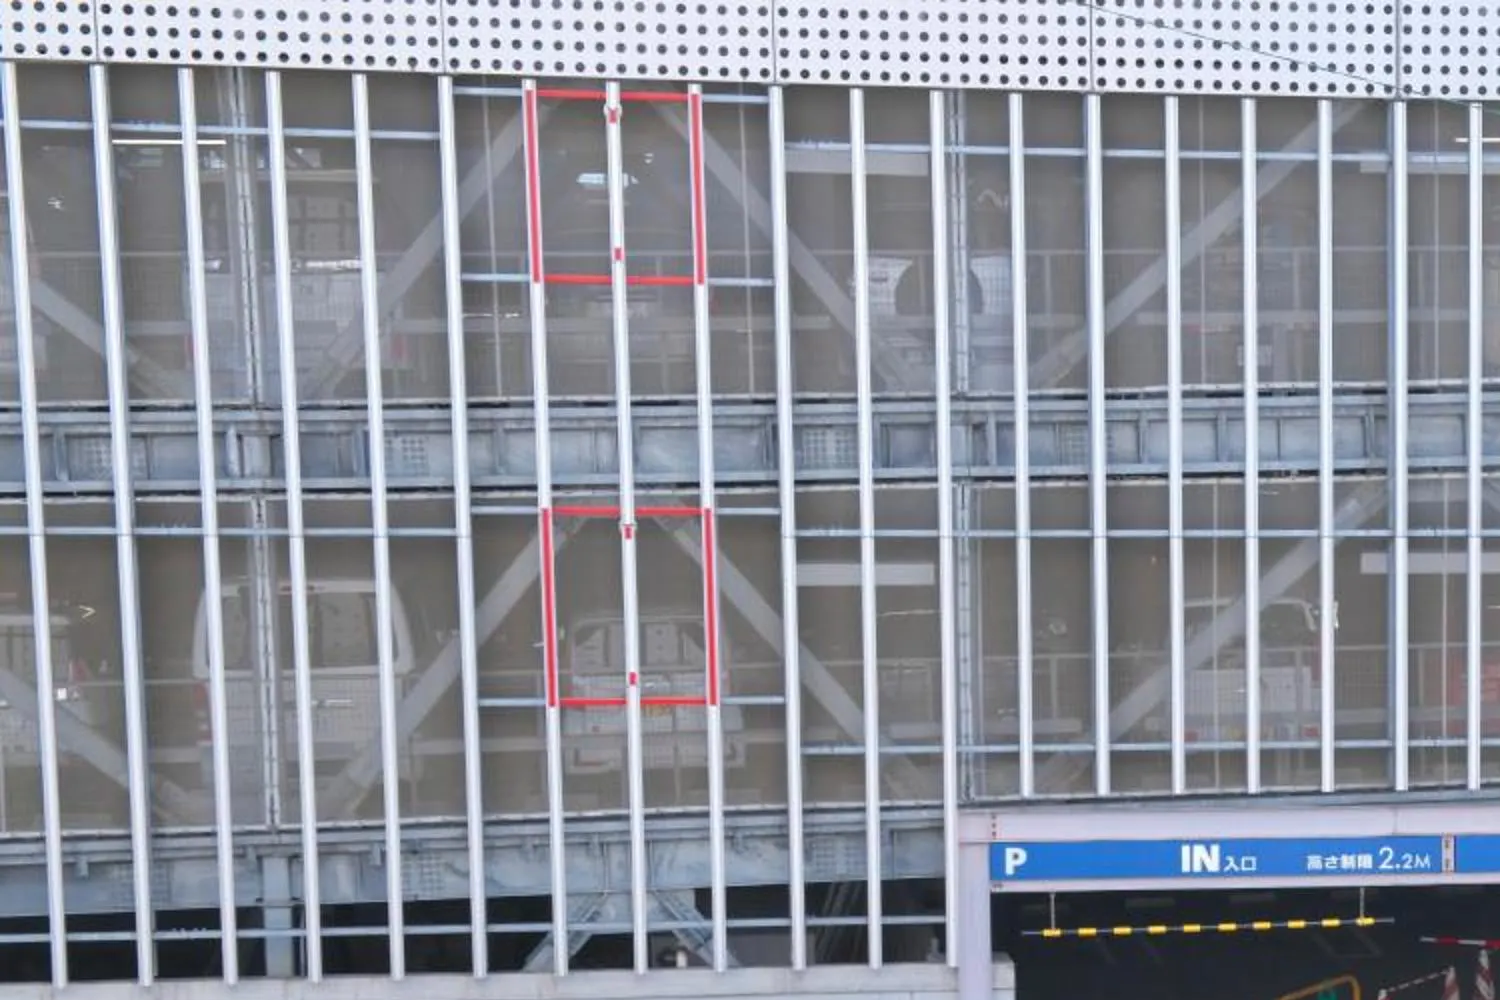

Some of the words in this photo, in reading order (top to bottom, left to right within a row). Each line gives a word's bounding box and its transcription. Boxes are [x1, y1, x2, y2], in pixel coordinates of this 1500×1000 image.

[1005, 847, 1028, 876] P
[1181, 844, 1220, 873] IN
[1223, 855, 1257, 872] 入口
